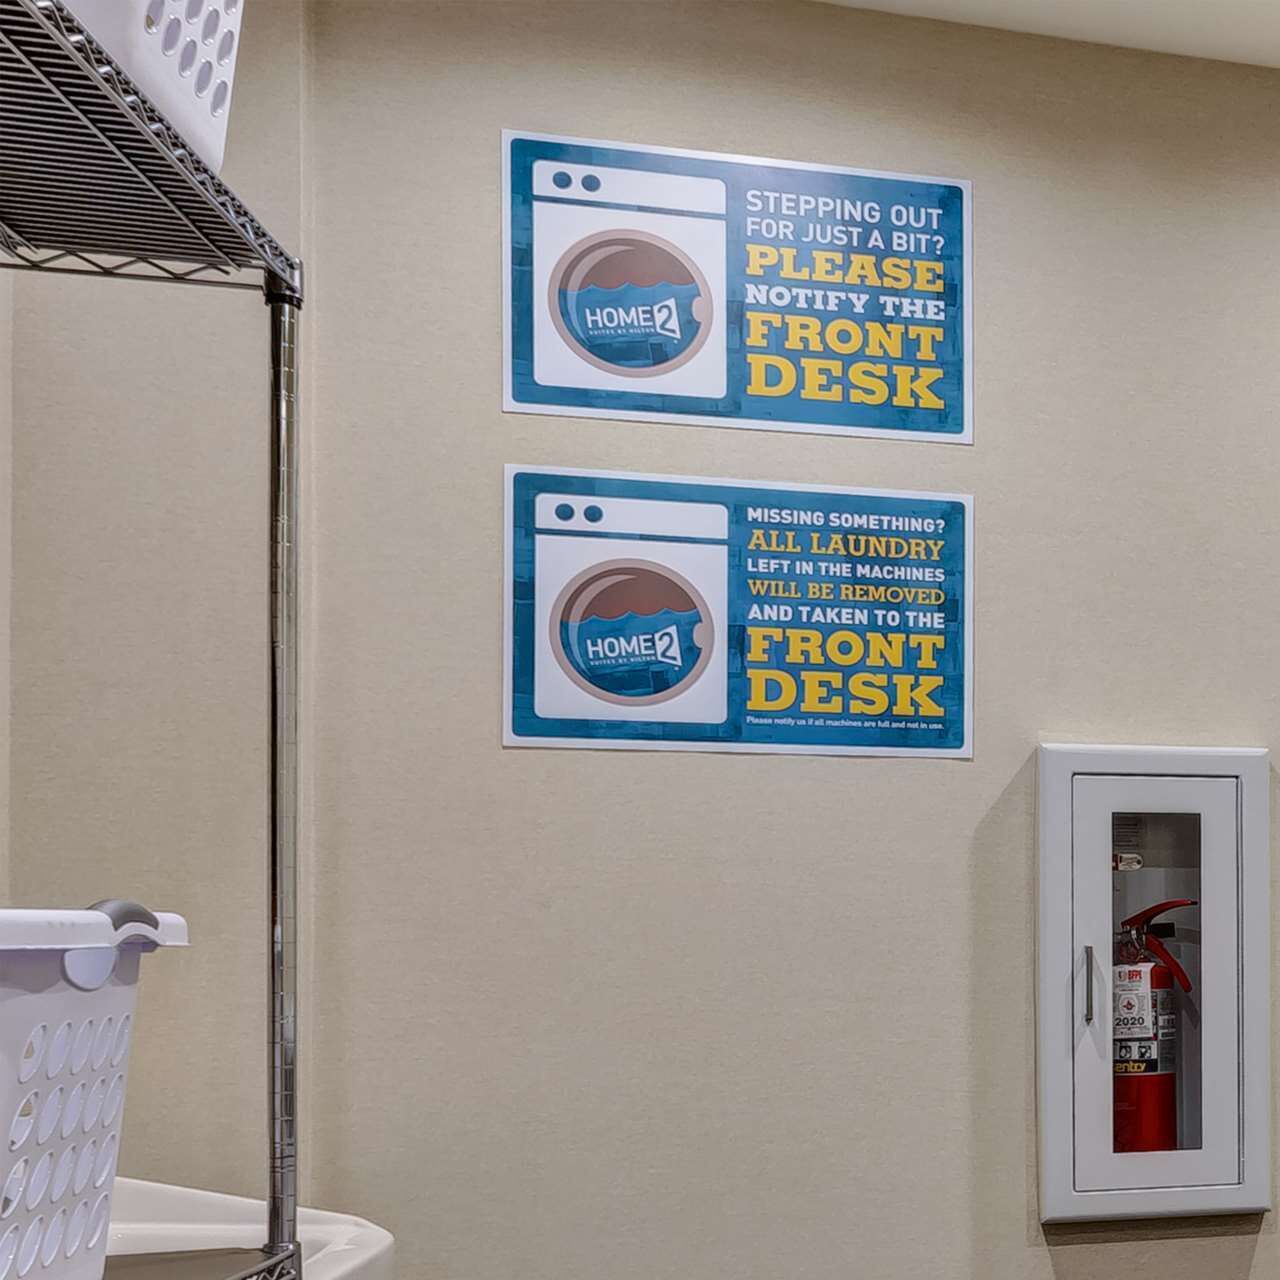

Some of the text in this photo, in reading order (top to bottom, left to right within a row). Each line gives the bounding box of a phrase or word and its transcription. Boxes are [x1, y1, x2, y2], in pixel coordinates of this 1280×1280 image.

[746, 190, 943, 230] STEPPING OUT
[746, 217, 945, 255] FOR JUST A BIT?
[745, 243, 945, 293] PLEASE
[745, 284, 946, 321] NOTIFY THE
[745, 311, 944, 361] FRONT
[746, 353, 945, 410] DESK
[747, 507, 945, 534] MISSING SOMETHING?
[747, 529, 945, 561] ALL LAUNDRY
[747, 558, 945, 582] LEFT IN THE MACHINES
[747, 579, 945, 605] WILL BE REMOVED
[748, 604, 945, 628] AND TAKEN TO THE
[746, 627, 944, 669] FRONT
[746, 668, 944, 717] DESK
[1115, 1016, 1145, 1026] 2020
